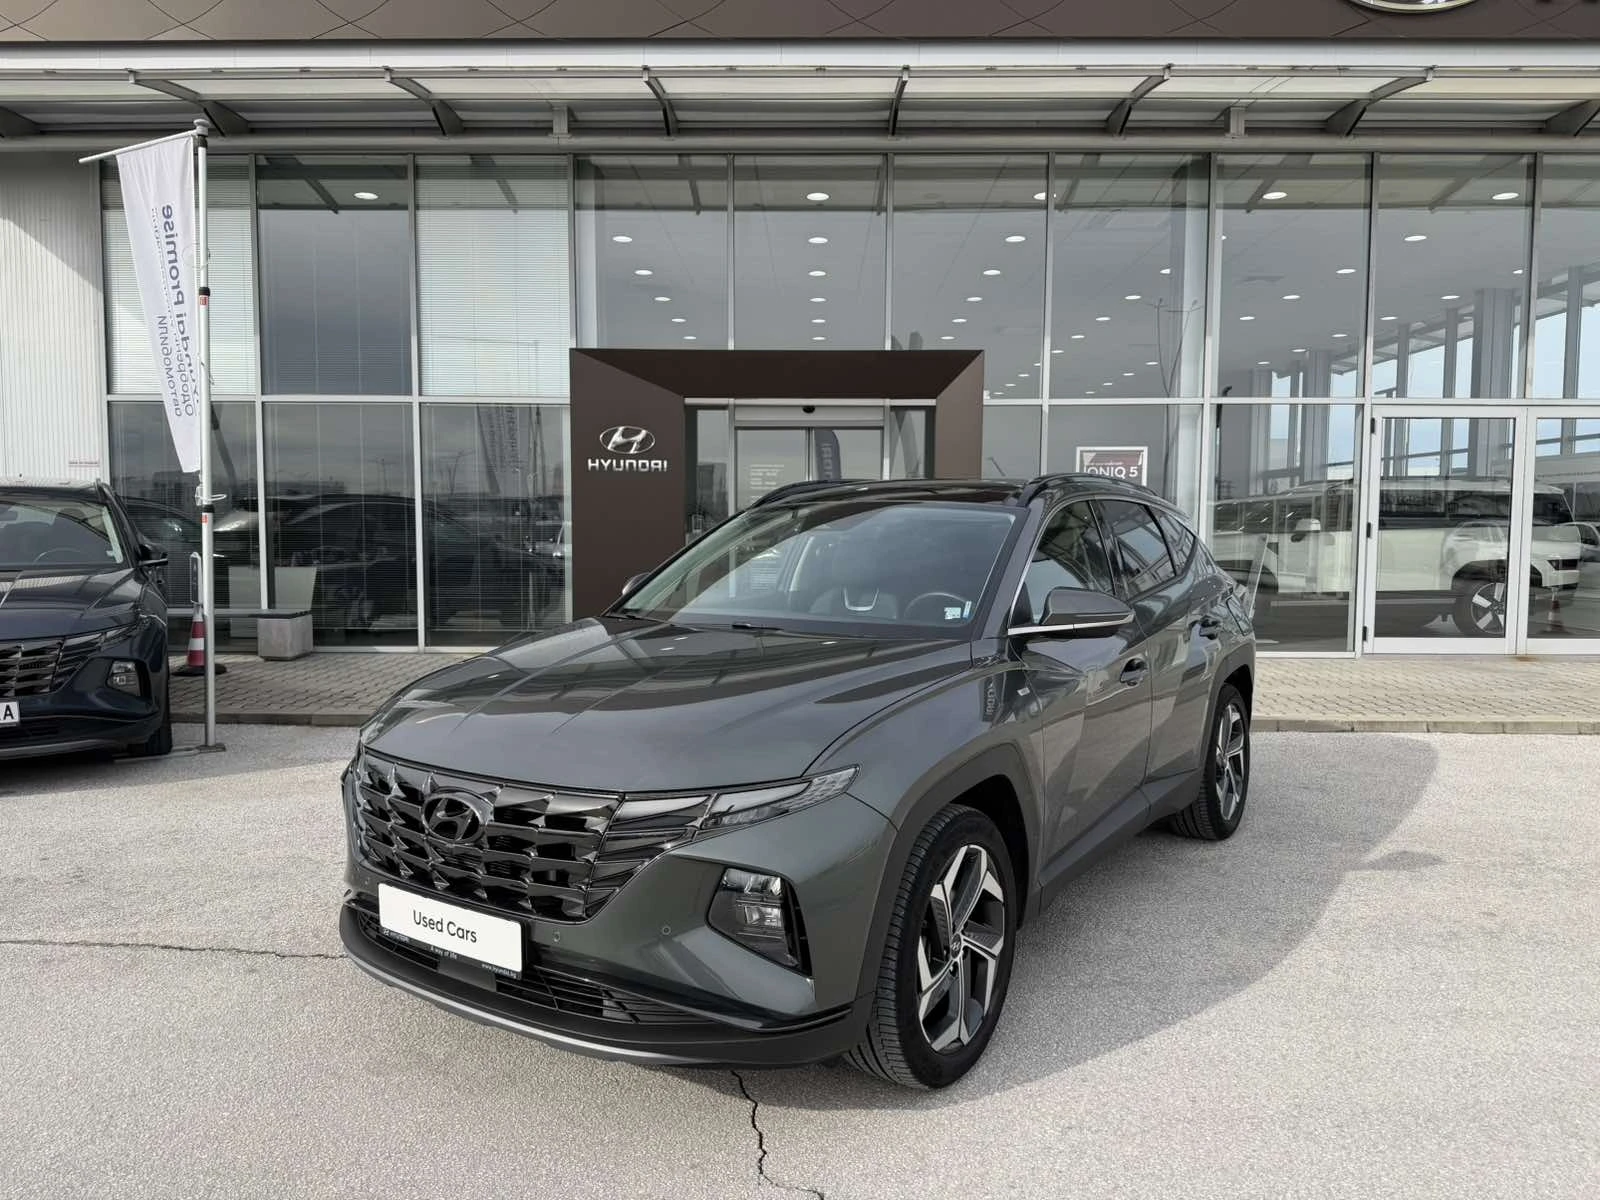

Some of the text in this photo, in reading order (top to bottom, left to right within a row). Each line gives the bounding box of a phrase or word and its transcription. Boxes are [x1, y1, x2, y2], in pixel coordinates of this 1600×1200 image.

[587, 458, 667, 472] HYUNDAI
[1129, 466, 1139, 477] 5
[0, 704, 14, 720] A
[413, 909, 477, 943] Used Cars
